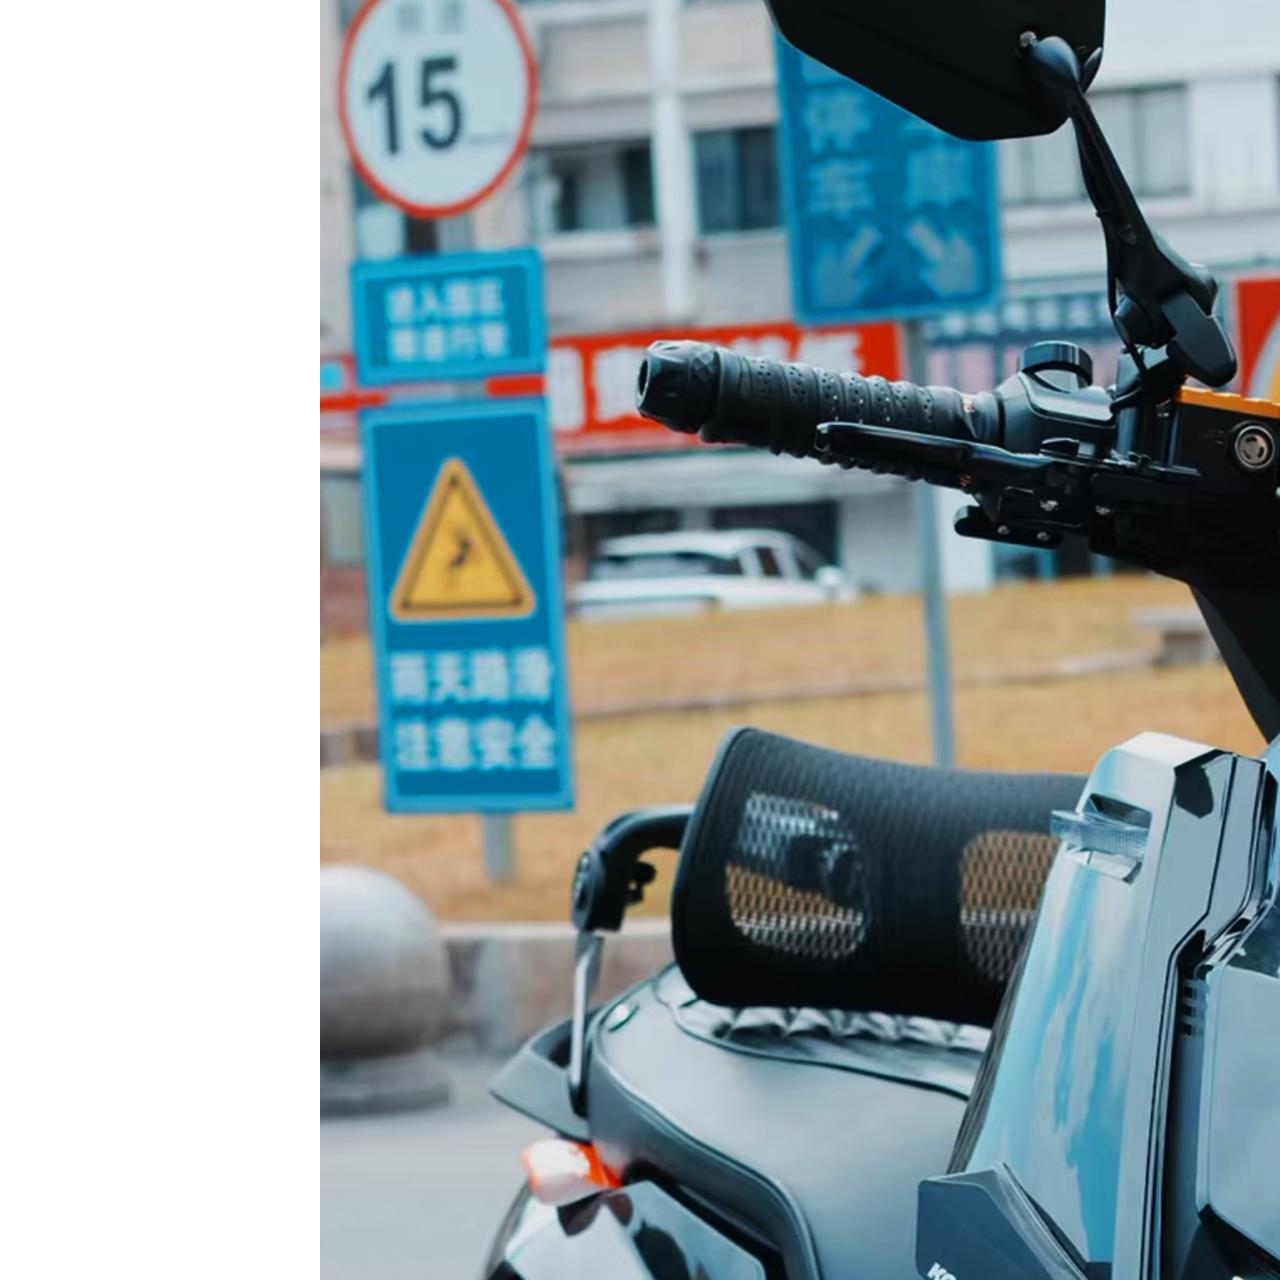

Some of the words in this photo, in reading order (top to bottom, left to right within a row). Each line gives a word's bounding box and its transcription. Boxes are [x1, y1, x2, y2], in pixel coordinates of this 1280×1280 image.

[368, 57, 461, 157] 15
[390, 645, 553, 704] 雨天路滑
[396, 713, 556, 772] 注意安全
